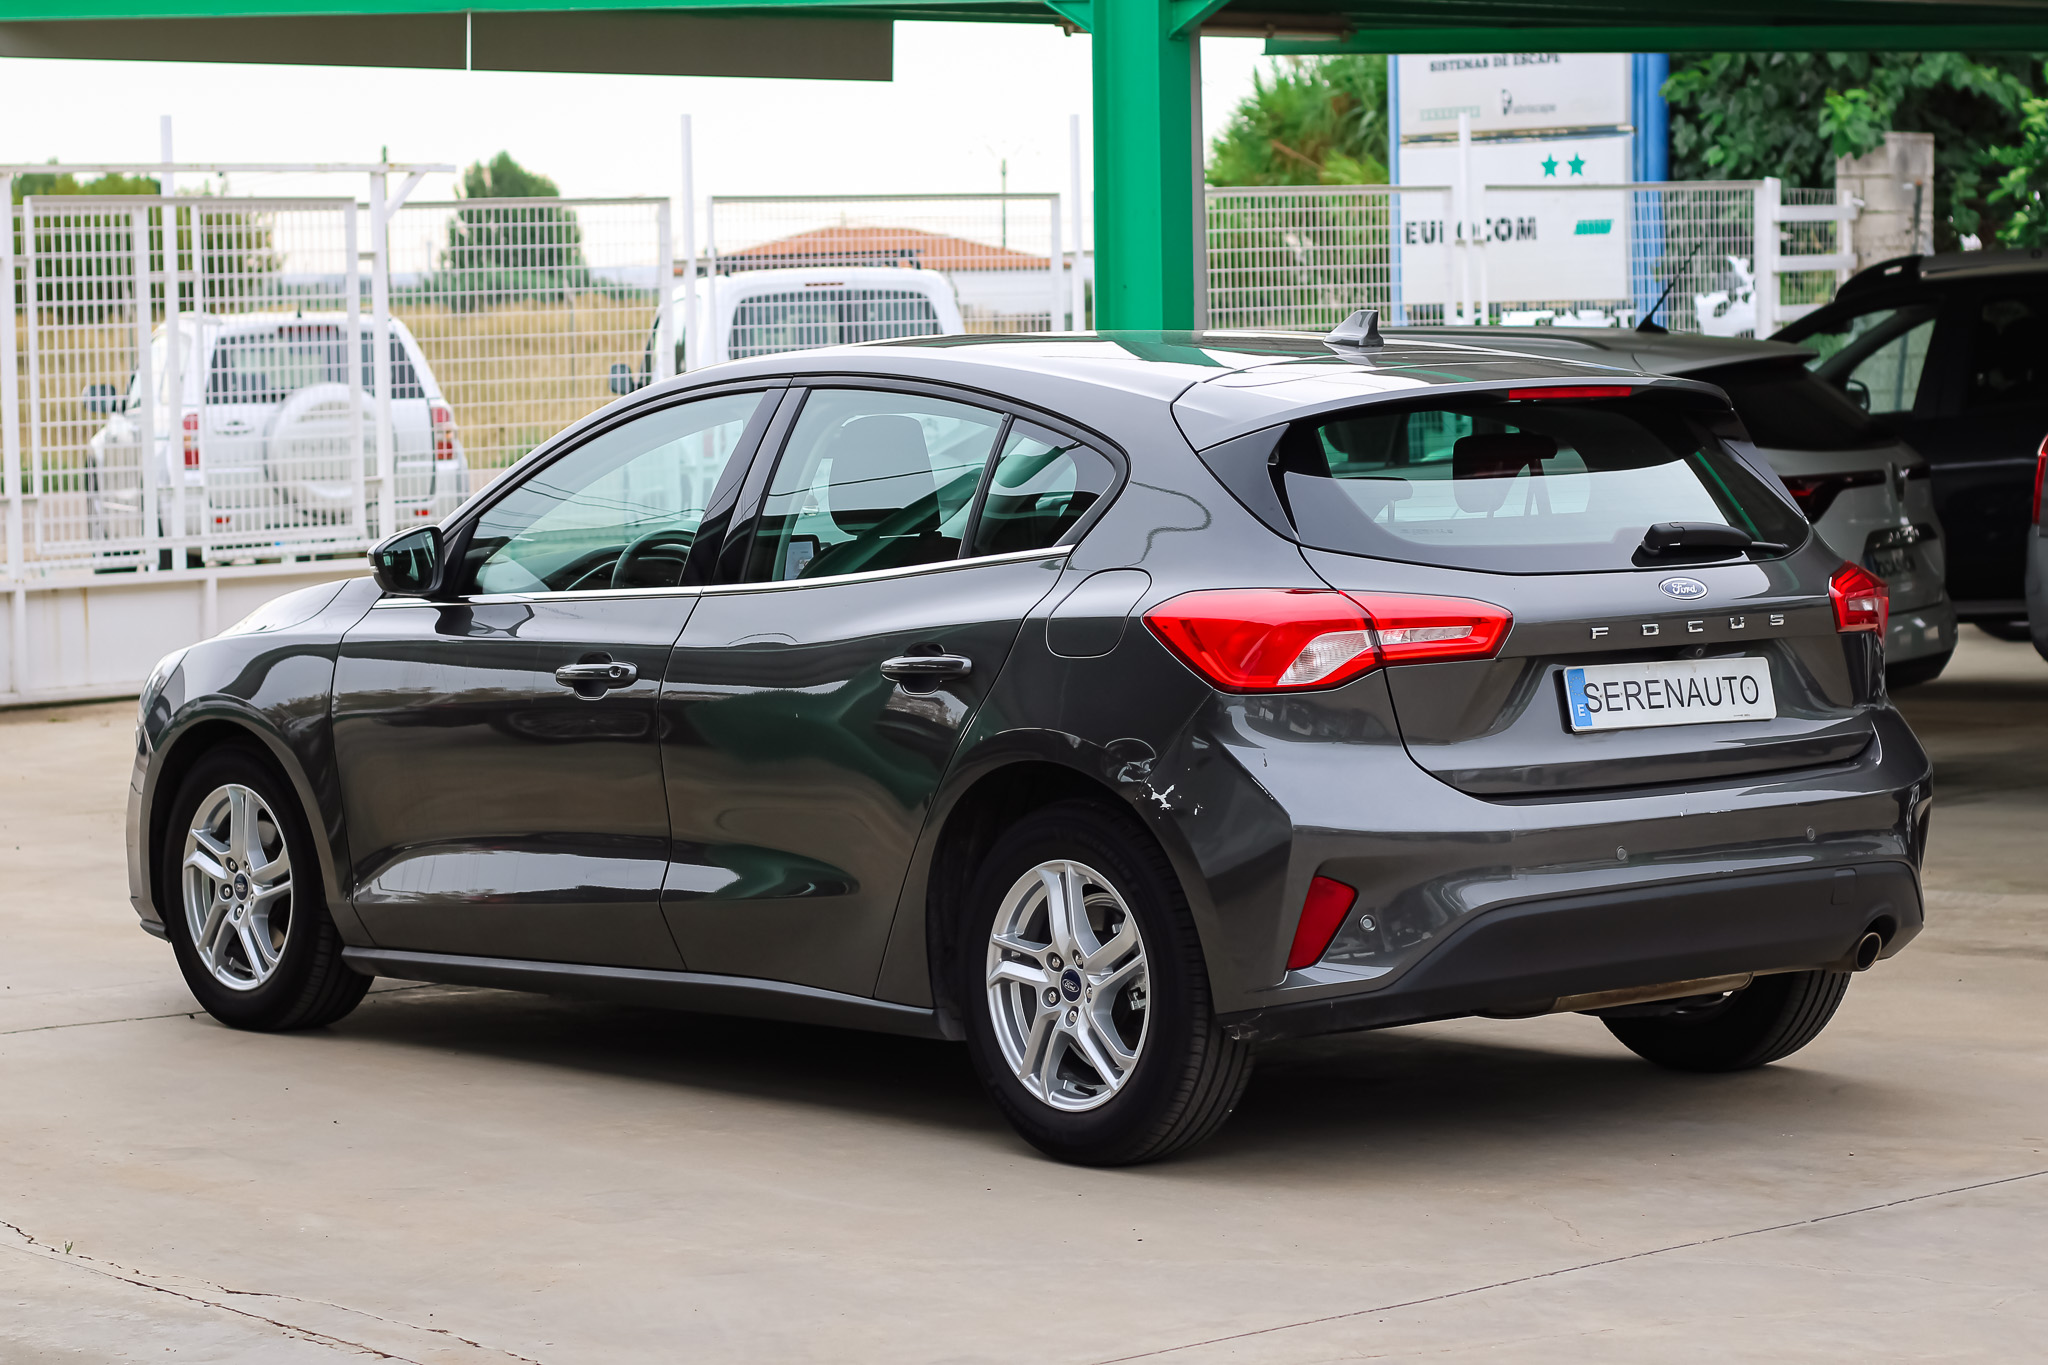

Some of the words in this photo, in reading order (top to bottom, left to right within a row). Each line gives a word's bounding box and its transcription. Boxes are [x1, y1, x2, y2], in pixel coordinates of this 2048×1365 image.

[1430, 58, 1489, 72] SISTEMAS
[1494, 54, 1508, 67] DE
[1671, 582, 1697, 595] Ford
[1590, 613, 1785, 640] FOCUS
[1583, 674, 1760, 713] SERENAUTO
[1577, 704, 1586, 718] E
